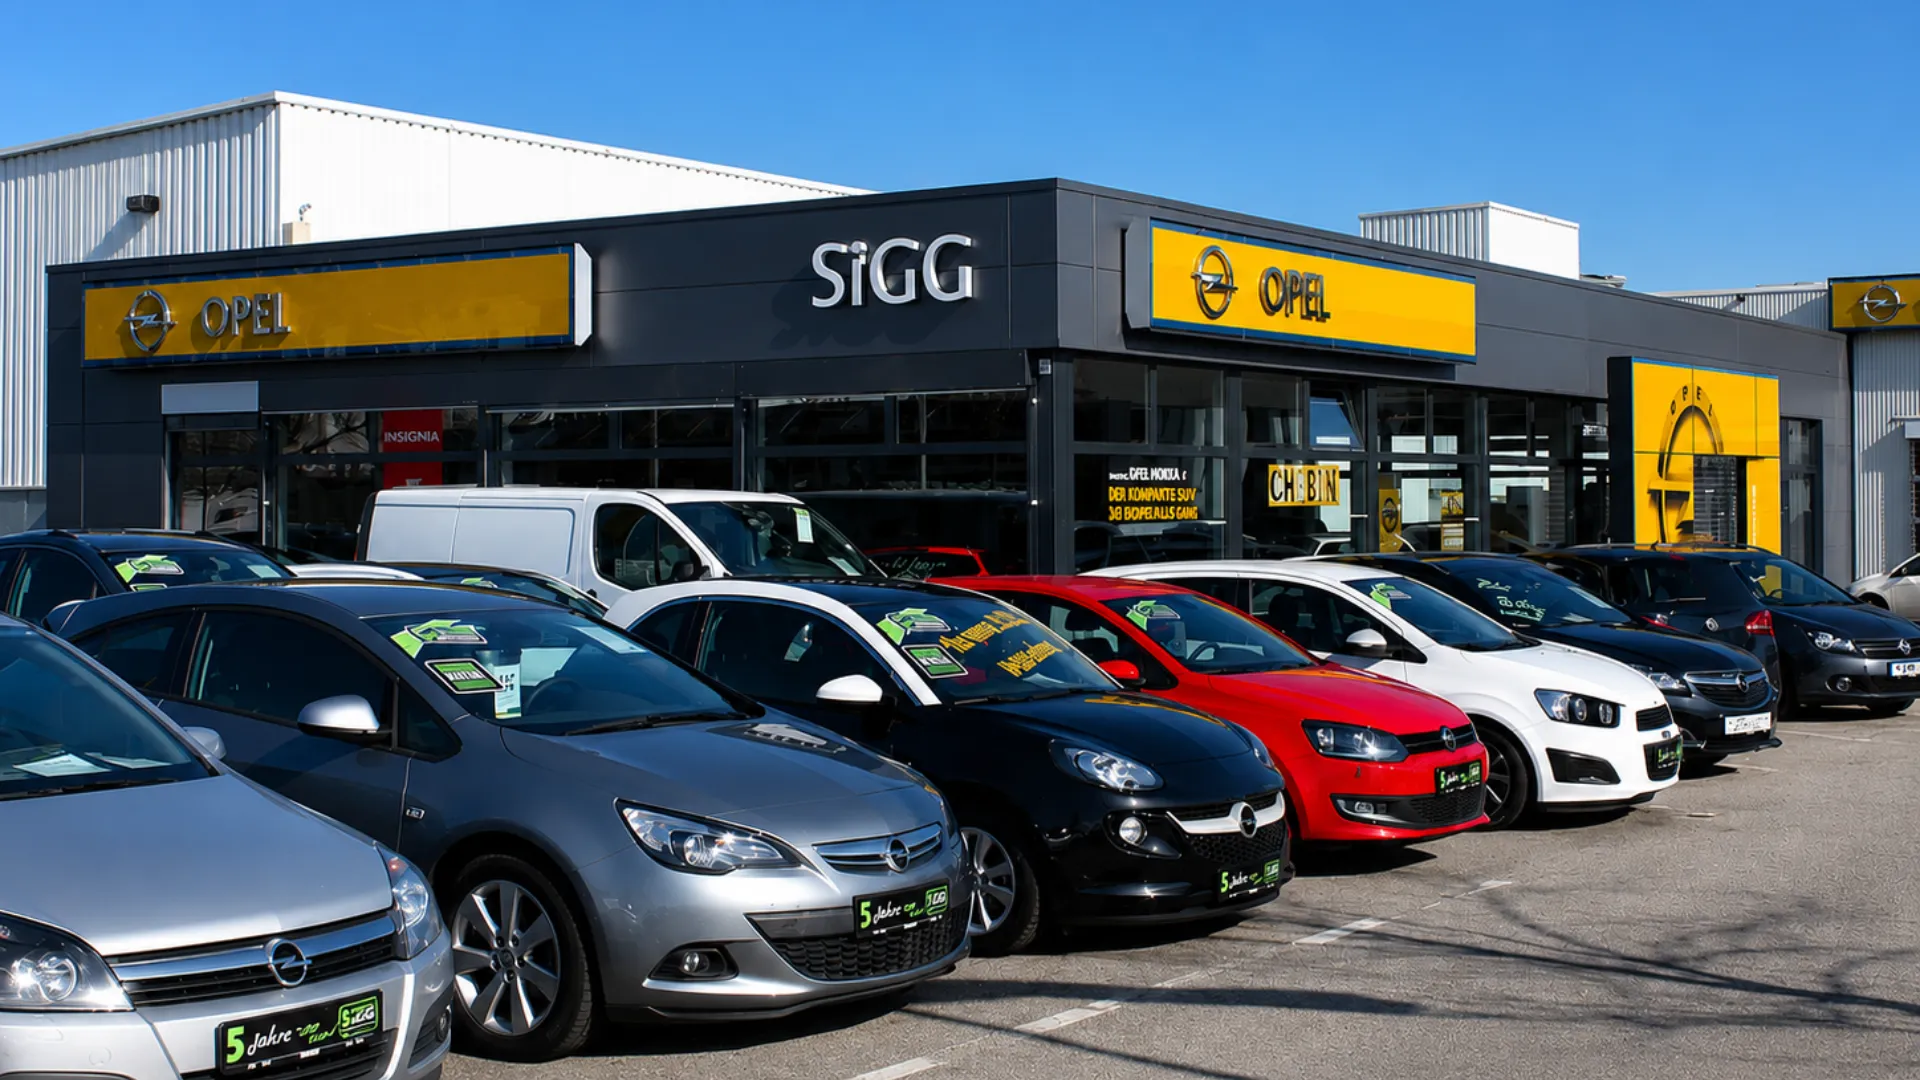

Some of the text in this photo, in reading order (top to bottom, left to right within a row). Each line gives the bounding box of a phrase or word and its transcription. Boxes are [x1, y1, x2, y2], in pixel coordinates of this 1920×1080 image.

[1259, 266, 1331, 323] OPEL
[201, 292, 291, 337] OPEL
[1670, 385, 1712, 417] OPEL
[384, 430, 440, 442] INSIGNIA
[861, 901, 871, 929] 5
[226, 1025, 245, 1064] 5
